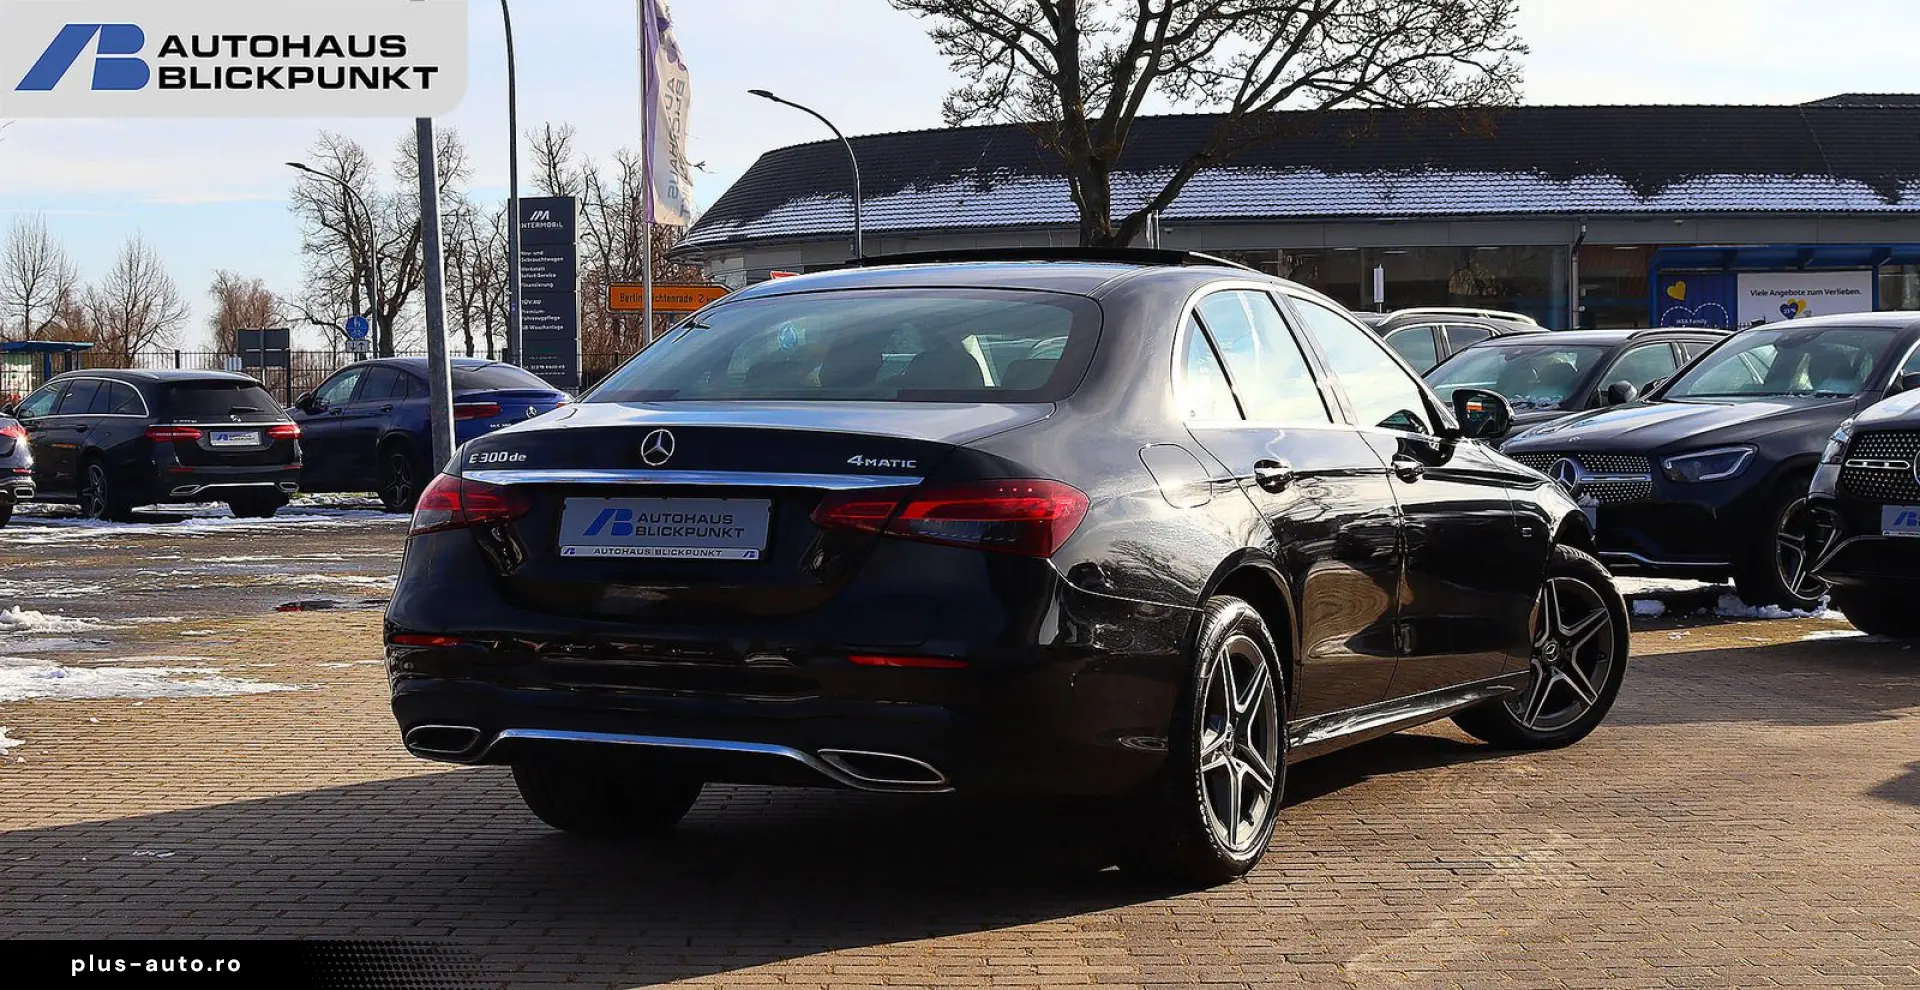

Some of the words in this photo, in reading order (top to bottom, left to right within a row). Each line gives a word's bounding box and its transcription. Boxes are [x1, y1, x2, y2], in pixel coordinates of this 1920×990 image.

[698, 293, 704, 302] 2
[1750, 288, 1768, 297] Viele
[1769, 288, 1806, 298] Angebote
[1824, 287, 1862, 296] Verlieben.
[847, 454, 917, 468] 4MATIC
[636, 513, 733, 524] AUTOHAUS
[635, 526, 745, 538] BLICKPUNKT
[593, 547, 650, 556] AUTOHAUS
[655, 548, 723, 558] BLICKPUNKT
